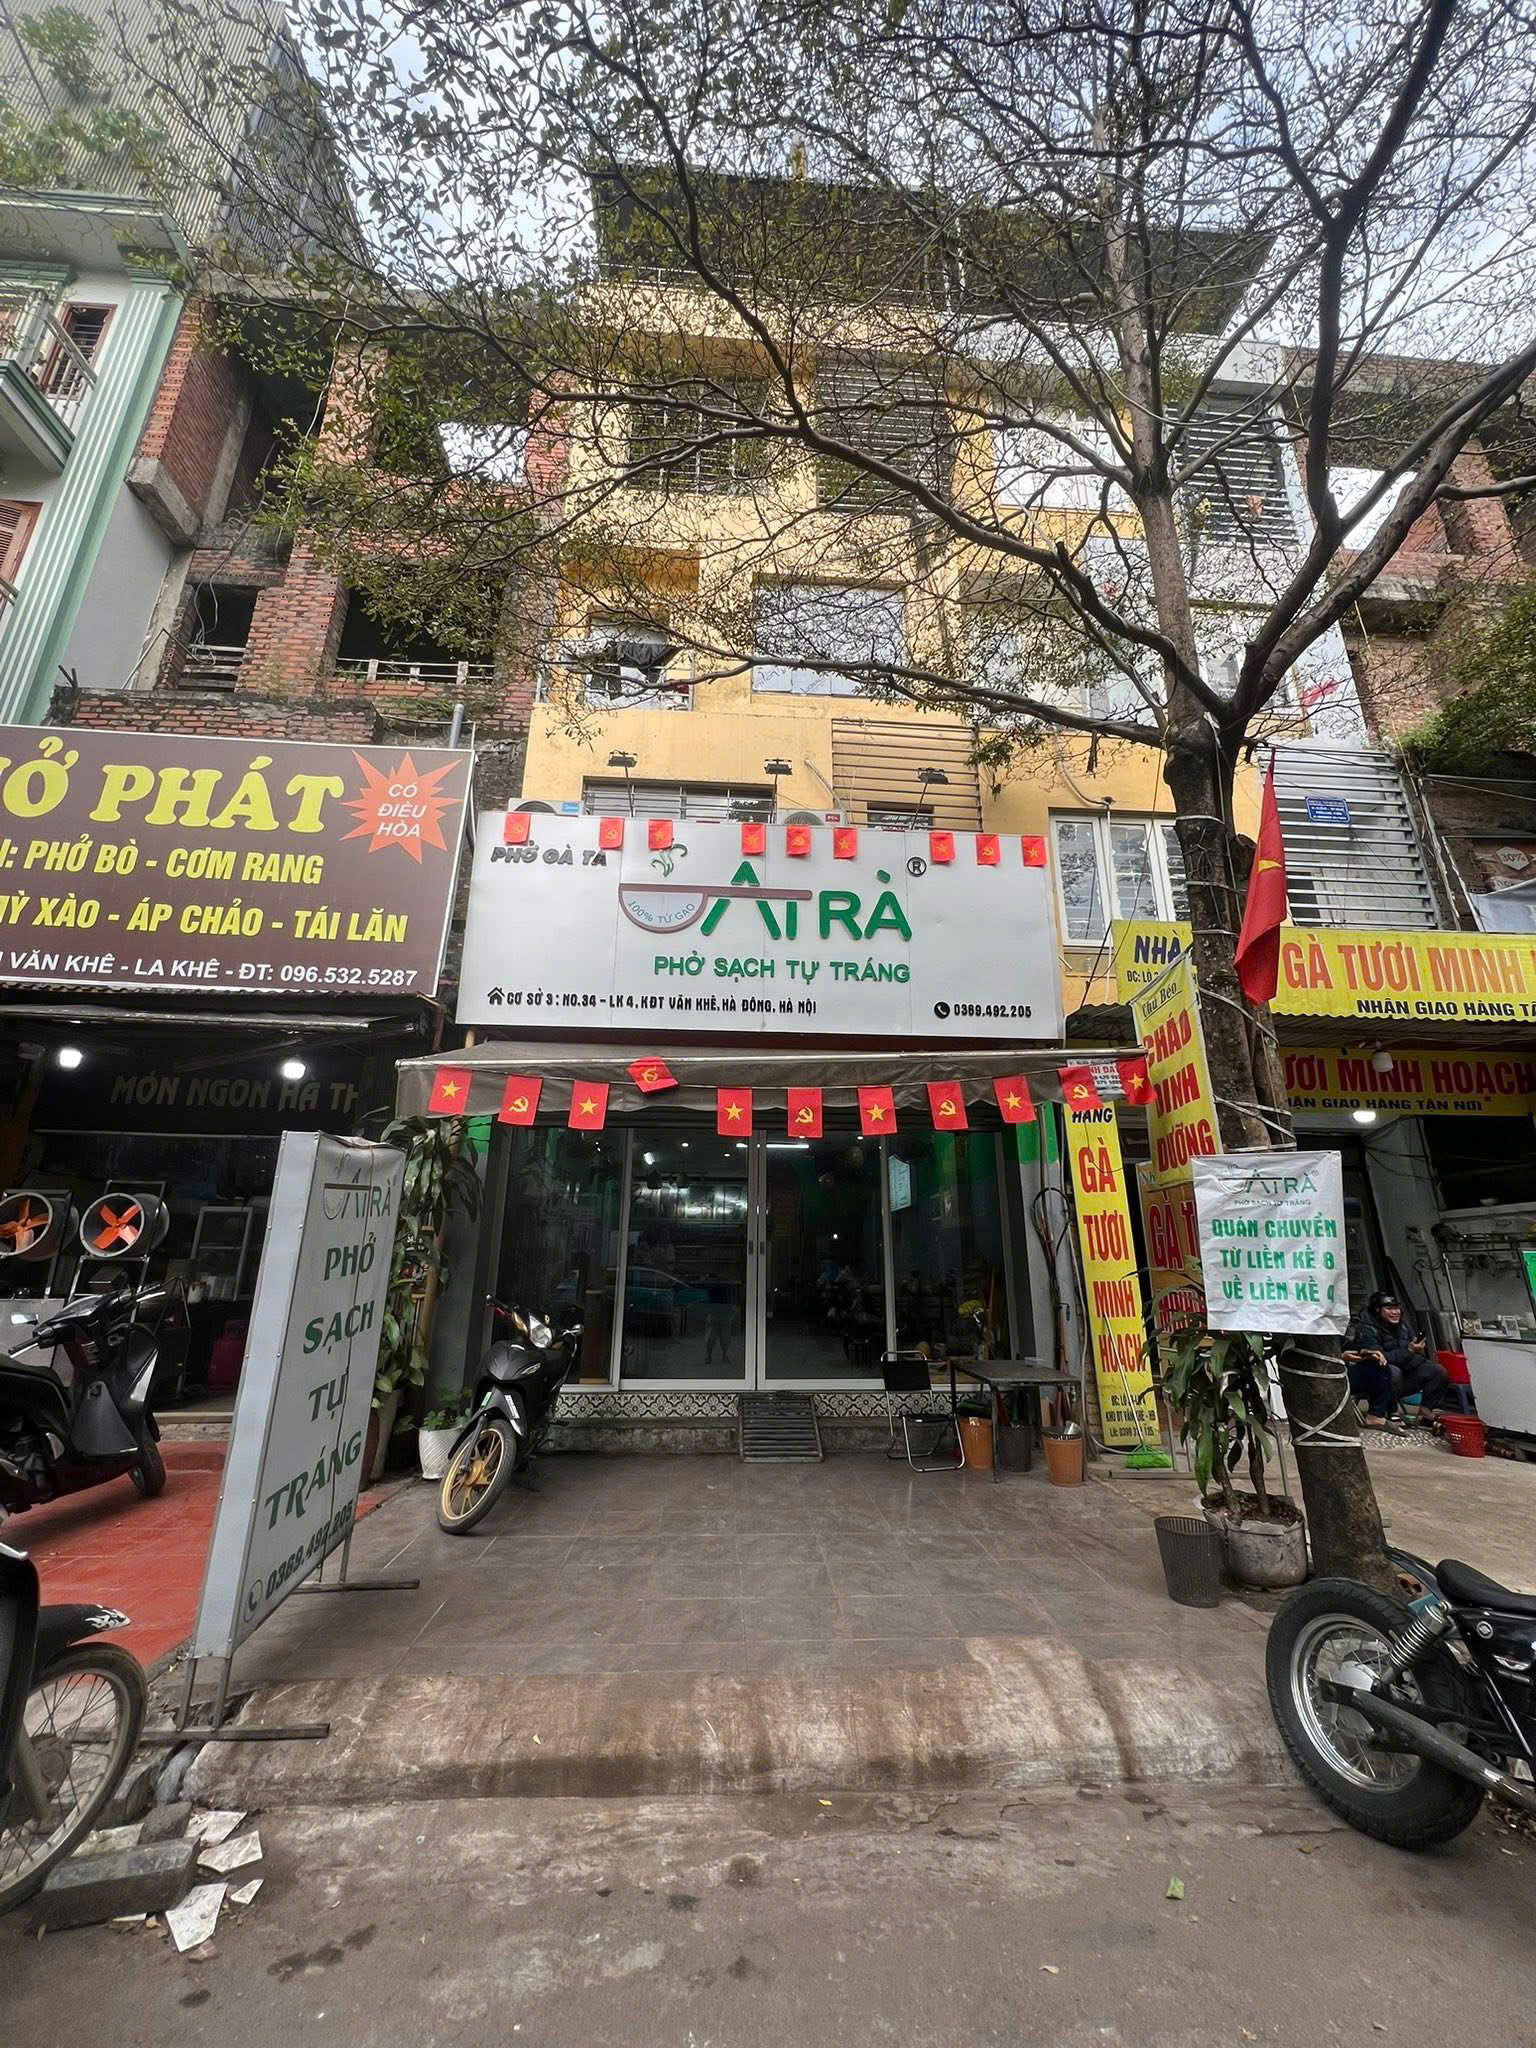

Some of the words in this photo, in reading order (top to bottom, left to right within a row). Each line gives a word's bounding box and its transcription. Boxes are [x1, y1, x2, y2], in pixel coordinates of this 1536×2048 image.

[0, 736, 79, 818] Ở
[89, 755, 345, 834] PHÁT
[389, 782, 418, 798] CÓ
[377, 819, 420, 838] HÒA
[23, 833, 93, 872] PHỞ
[94, 838, 139, 875] BÒ
[166, 847, 236, 880] CƠM
[242, 852, 324, 884] RANG
[490, 840, 539, 864] PHỞ
[582, 850, 607, 867] TA
[32, 893, 100, 929] XÀO
[127, 897, 173, 932] ÁP
[179, 898, 264, 936] CHẢO
[294, 906, 341, 940] TÁI
[347, 908, 409, 943] LĂN
[628, 901, 653, 922] 100%
[10, 949, 59, 970] VĂN
[64, 953, 115, 974] KHÊ
[134, 958, 165, 977] LA
[170, 958, 220, 978] KHÊ
[239, 963, 273, 982] ĐT:
[280, 964, 418, 987] 096.532.5287
[654, 950, 705, 976] PHỞ
[713, 957, 775, 983] SẠCH
[786, 960, 820, 985] TỰ
[829, 957, 911, 984] TRÁNG
[1282, 933, 1333, 990] GÀ
[1337, 941, 1422, 992] TƯƠI
[1427, 946, 1528, 994] MINH
[507, 992, 522, 1005] CƠ
[527, 988, 543, 1005] SỞ
[609, 995, 624, 1008] LK
[641, 995, 665, 1009] KĐT
[669, 994, 692, 1010] VĂN
[722, 995, 736, 1011] HÀ
[779, 997, 793, 1013] HÀ
[798, 998, 817, 1016] NỘI
[1357, 998, 1409, 1018] NHẬN
[1415, 1001, 1458, 1016] GIAO
[1464, 999, 1515, 1017] HÀNG
[186, 1078, 272, 1109] NGON
[1154, 1063, 1200, 1119] DINH
[1337, 1058, 1424, 1093] MINH
[1322, 1099, 1361, 1109] GIAO
[1366, 1097, 1411, 1110] HÀNG
[1455, 1099, 1483, 1110] NƠI
[1156, 1118, 1216, 1173] DƯỠNG
[1078, 1137, 1117, 1194] GÀ
[1083, 1209, 1129, 1262] TƯƠI
[1148, 1191, 1184, 1271] GÀ
[1211, 1216, 1258, 1238] QUÁN
[1264, 1212, 1337, 1239] CHUYỂN
[324, 1232, 377, 1281] PHỞ
[1220, 1246, 1242, 1268] TỪ
[1293, 1244, 1316, 1269] KỀ
[1323, 1251, 1335, 1270] 8
[1093, 1280, 1136, 1318] MINH
[1222, 1274, 1243, 1299] VỀ
[1295, 1276, 1320, 1302] KỀ
[303, 1300, 375, 1355] SẠCH
[308, 1368, 349, 1422] TỰ
[265, 1431, 362, 1530] TRÁNG
